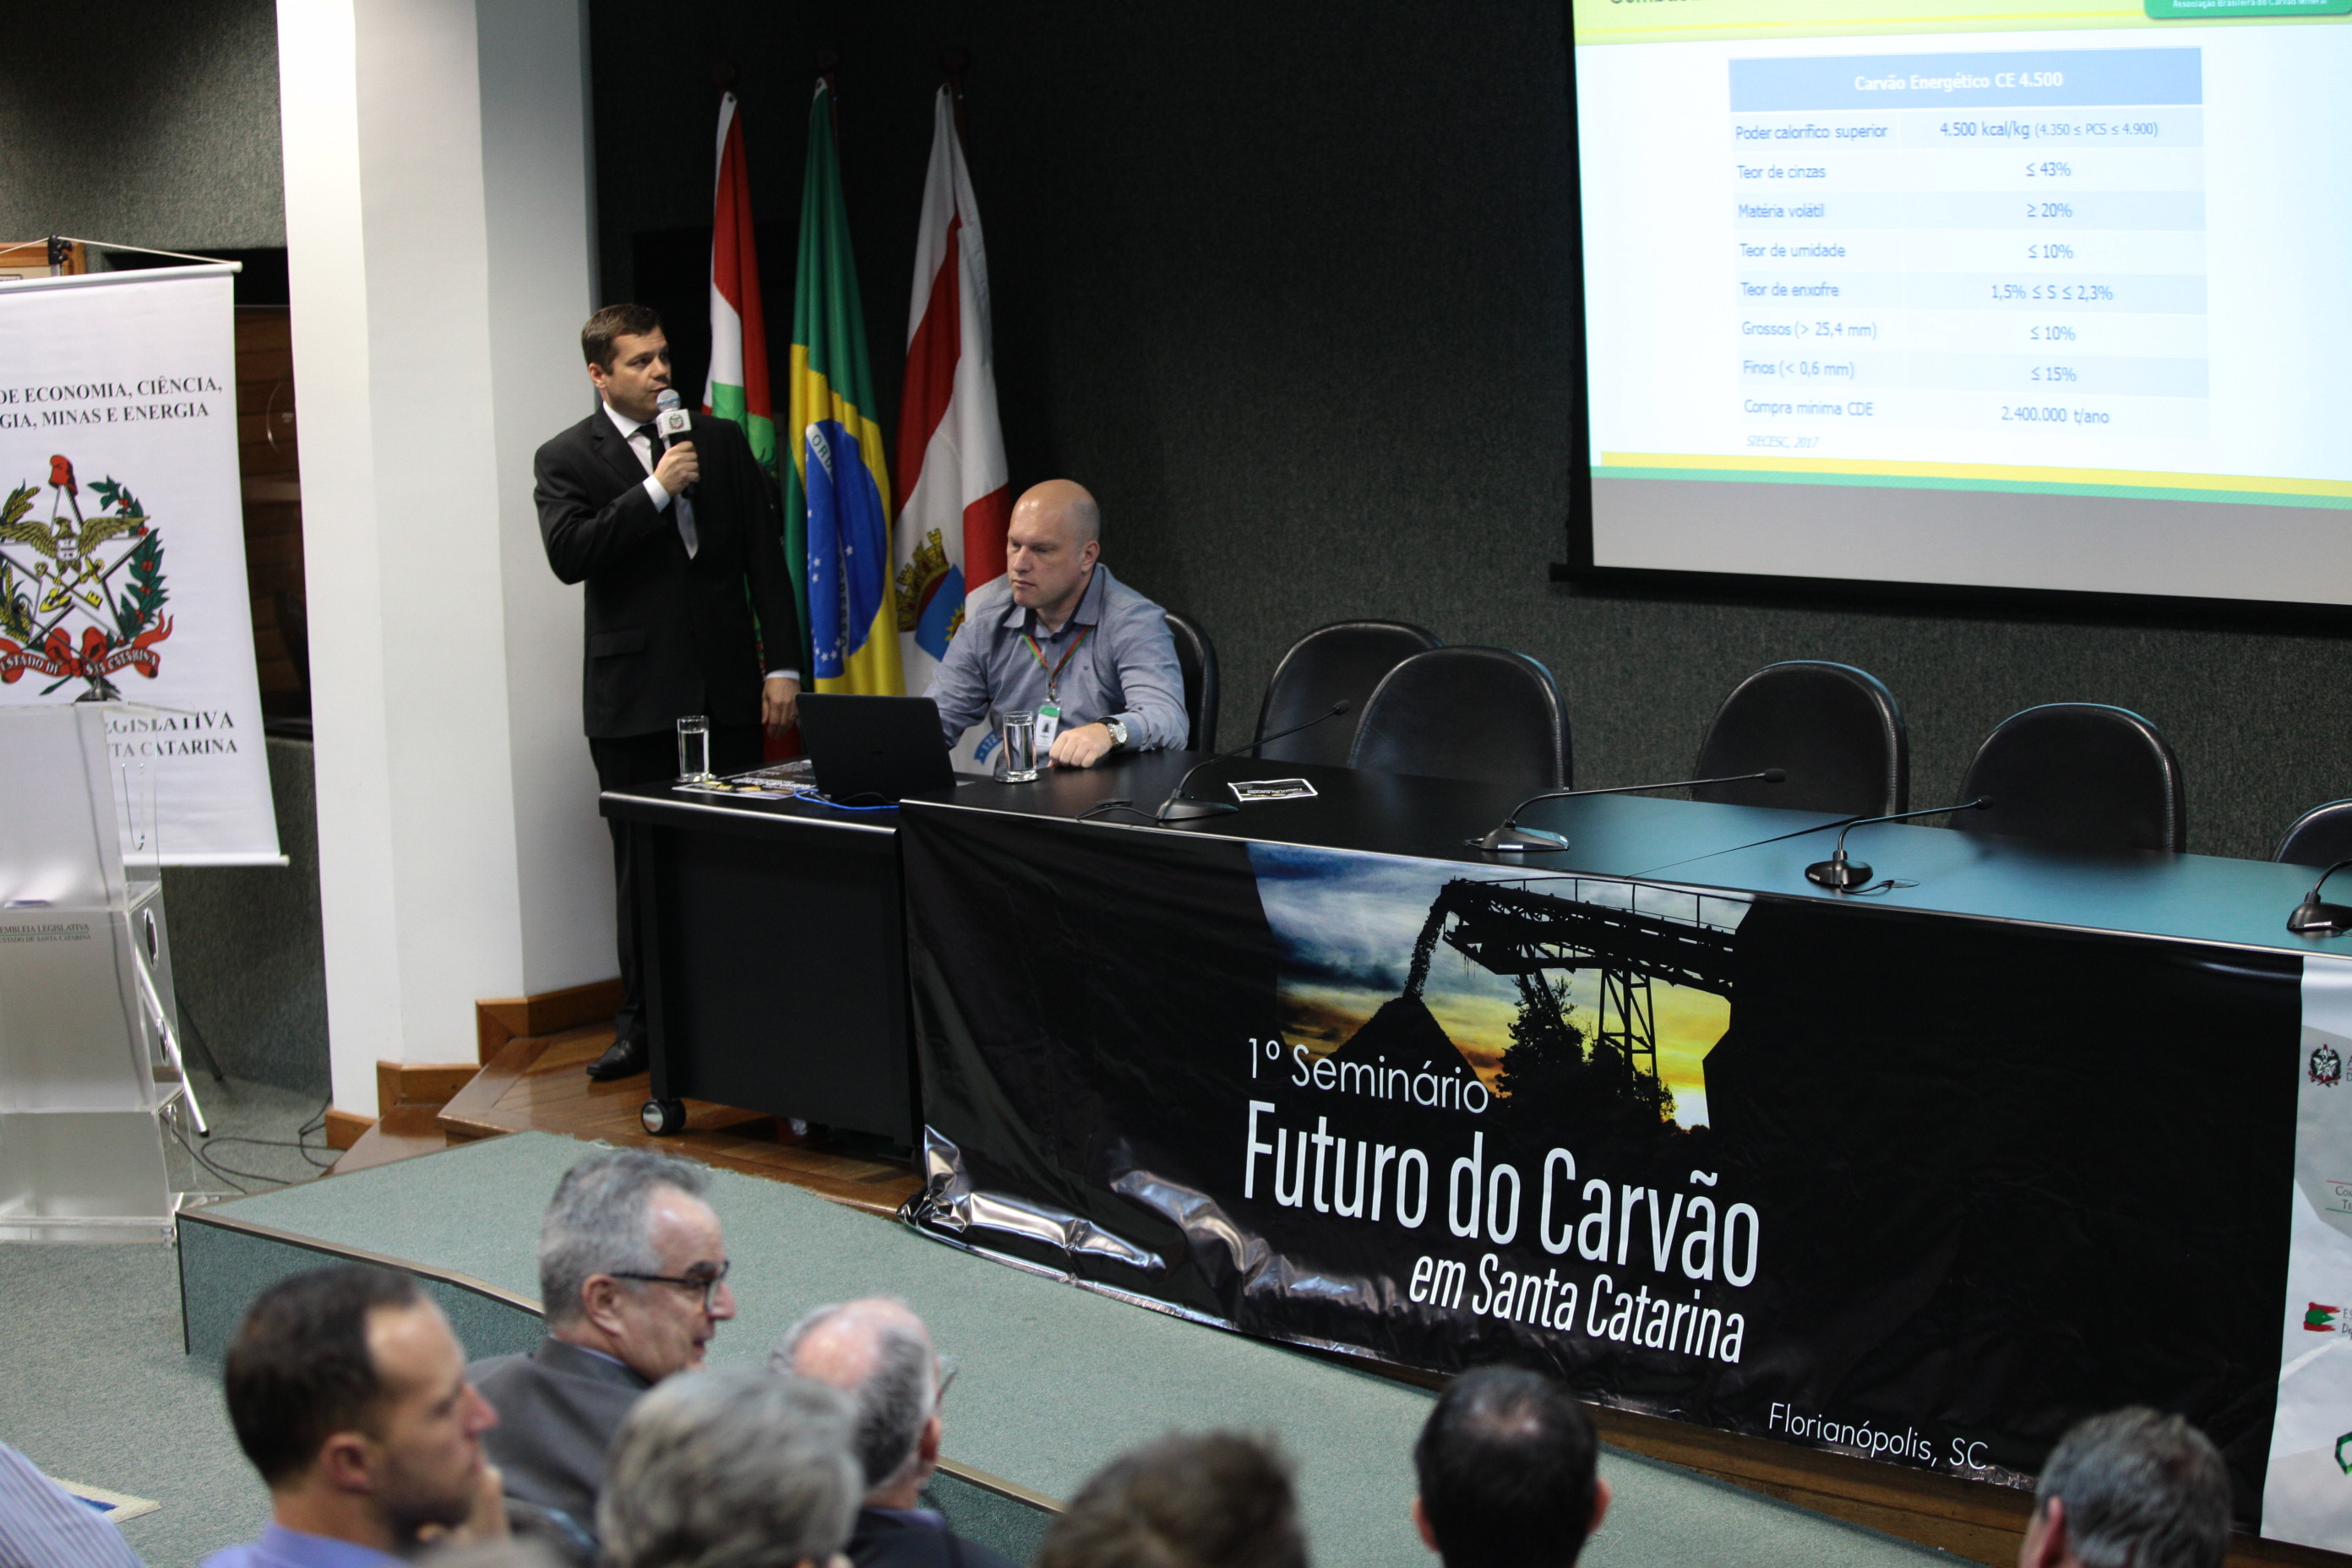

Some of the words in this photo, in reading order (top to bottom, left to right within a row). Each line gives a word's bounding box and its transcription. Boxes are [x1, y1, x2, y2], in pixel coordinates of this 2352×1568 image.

[1854, 74, 1906, 91] Carvão
[1909, 71, 1990, 93] Energético
[1995, 73, 2016, 88] CE
[2018, 72, 2063, 87] 4.500
[1735, 125, 1772, 139] Poder
[1774, 123, 1830, 140] calorífico
[1835, 123, 1888, 141] superior
[1940, 122, 1976, 137] 4.500
[1981, 120, 2030, 140] kcal/kg
[2034, 122, 2070, 139] (4.350
[2085, 122, 2107, 135] PCS
[2121, 122, 2159, 138] 4.900)
[1736, 165, 1763, 178] Teor
[1767, 164, 1784, 178] de
[1788, 164, 1827, 178] cinzas
[2039, 161, 2072, 177] 43%
[1738, 203, 1784, 218] Matéria
[1788, 203, 1826, 218] volátil
[2041, 202, 2072, 218] 20%
[1739, 242, 1767, 258] Teor
[1770, 242, 1787, 258] de
[1790, 242, 1846, 258] umidade
[2043, 243, 2074, 259] 10%
[1740, 281, 1767, 297] Teor
[1771, 281, 1788, 297] de
[1791, 280, 1839, 297] enxofre
[1991, 284, 2027, 301] 1,5%
[2046, 284, 2056, 299] S
[2077, 285, 2114, 302] 2,3%
[1741, 320, 1792, 335] Grossos
[1815, 321, 1843, 340] 25,4
[1848, 321, 1877, 340] mm)
[2044, 325, 2077, 341] 10%
[1743, 359, 1776, 374] Finos
[1799, 361, 1820, 378] 0,6
[1823, 361, 1855, 379] mm)
[2045, 366, 2077, 382] 15%
[24, 382, 133, 403] ECONOMIA,
[137, 375, 222, 396] CIÊNCIA,
[41, 408, 102, 427] MINAS
[106, 407, 117, 422] E
[123, 402, 210, 422] ENERGIA
[1744, 399, 1793, 416] Compra
[1796, 400, 1843, 416] mínima
[1847, 401, 1875, 416] CDE
[2001, 406, 2067, 422] 2.400.000
[2073, 407, 2110, 426] t/ano
[1794, 437, 1820, 449] 2017
[140, 738, 238, 758] CATARINA
[37, 923, 90, 933] LEGISLATIVA
[1292, 1043, 1489, 1113] Seminário
[1244, 1099, 1429, 1228] Futuro
[1448, 1130, 1522, 1245] do
[1540, 1147, 1759, 1288] Carvão
[1408, 1255, 1467, 1309] em
[1472, 1253, 1578, 1331] Santa
[1587, 1273, 1745, 1364] Catarina
[1769, 1402, 1937, 1467] Florianópolis,
[1949, 1437, 1989, 1469] SC
